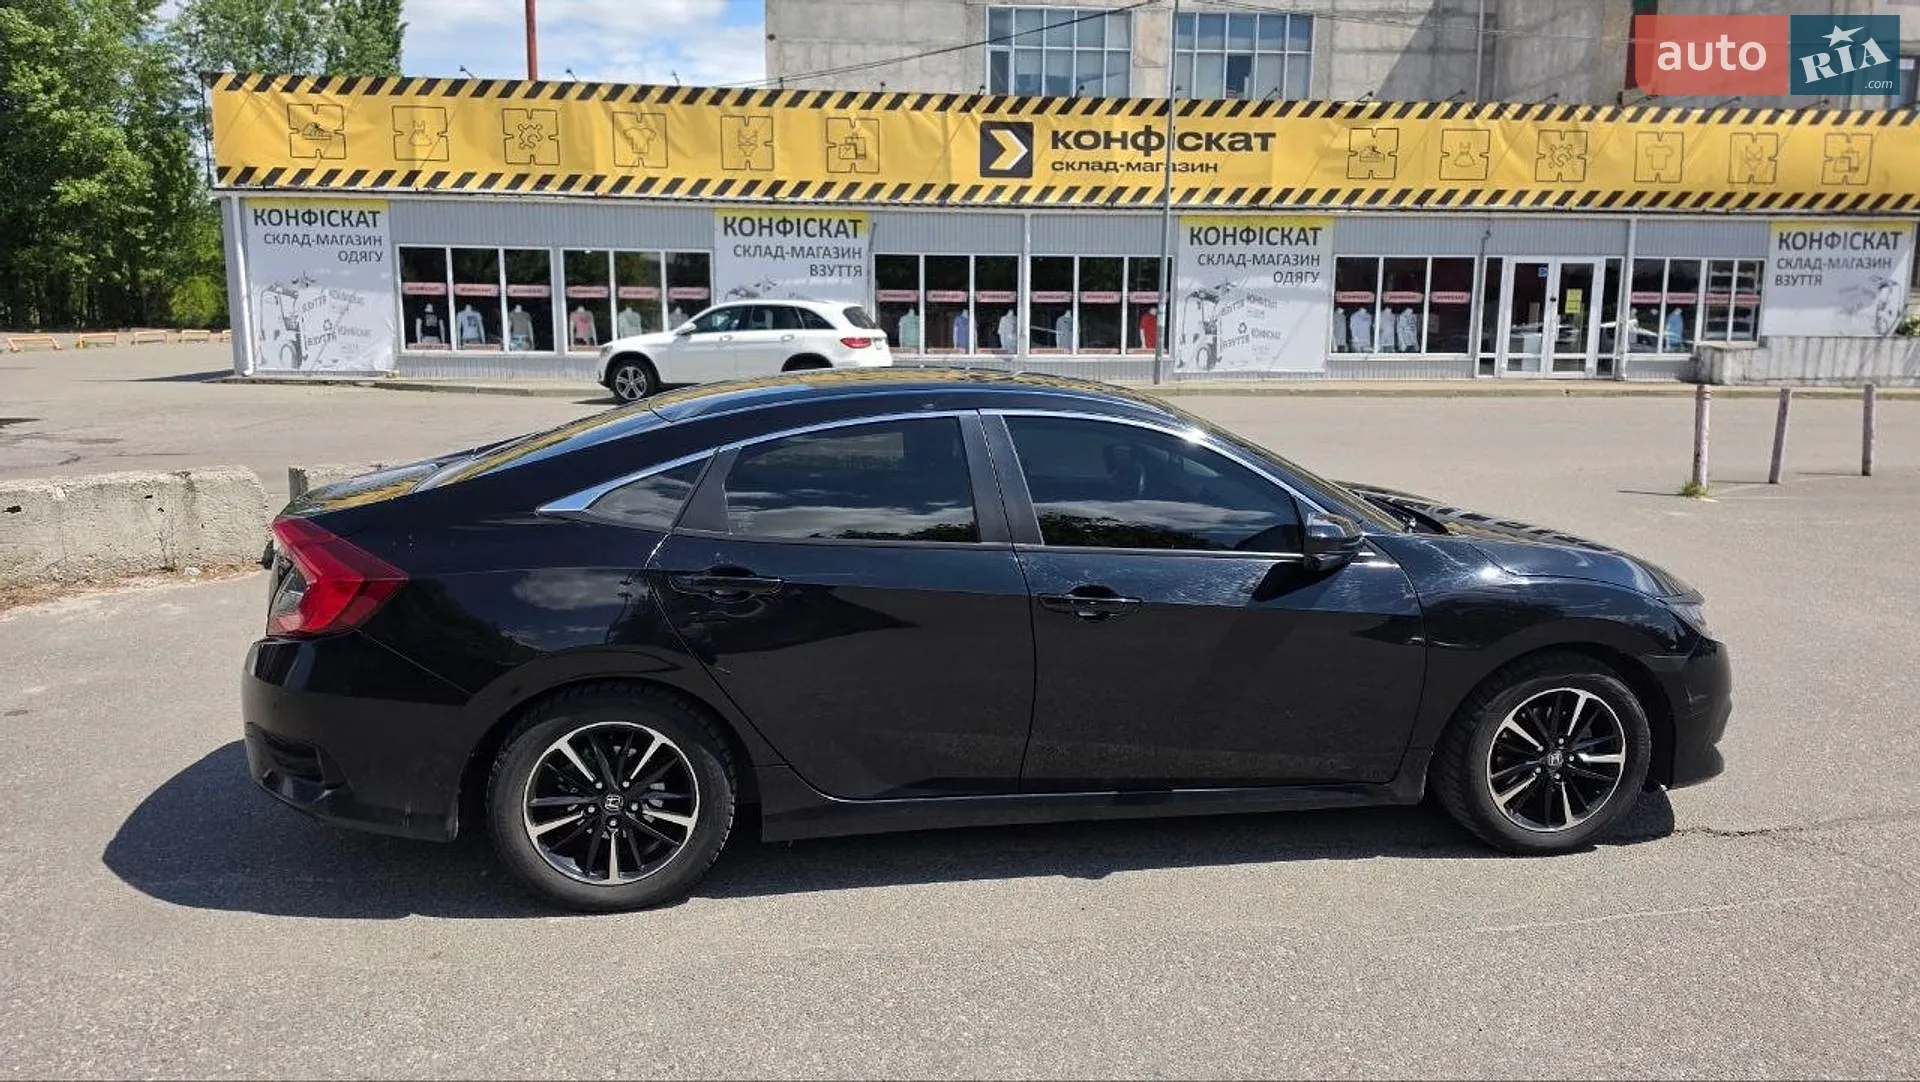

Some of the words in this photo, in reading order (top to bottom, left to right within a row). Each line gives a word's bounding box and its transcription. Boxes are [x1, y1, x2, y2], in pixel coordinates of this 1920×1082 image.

[253, 208, 380, 228] КОНФІСКАТ
[723, 216, 863, 239] КОНФІСКАТ
[264, 233, 383, 248] СКЛАД-МАГАЗИН
[1189, 226, 1323, 246] КОНФІСКАТ
[1778, 231, 1903, 251] КОНФІСКАТ
[337, 250, 383, 264] ОДЯГУ
[733, 244, 862, 261] СКЛАД-МАГАЗИН
[1198, 253, 1320, 268] СКЛАД-МАГАЗИН
[1777, 257, 1893, 271] СКЛАД-МАГАЗИН
[809, 263, 862, 277] ВЗУТТЯ
[1273, 271, 1320, 286] ОДЯГУ
[1774, 274, 1823, 287] ВЗУТТЯ
